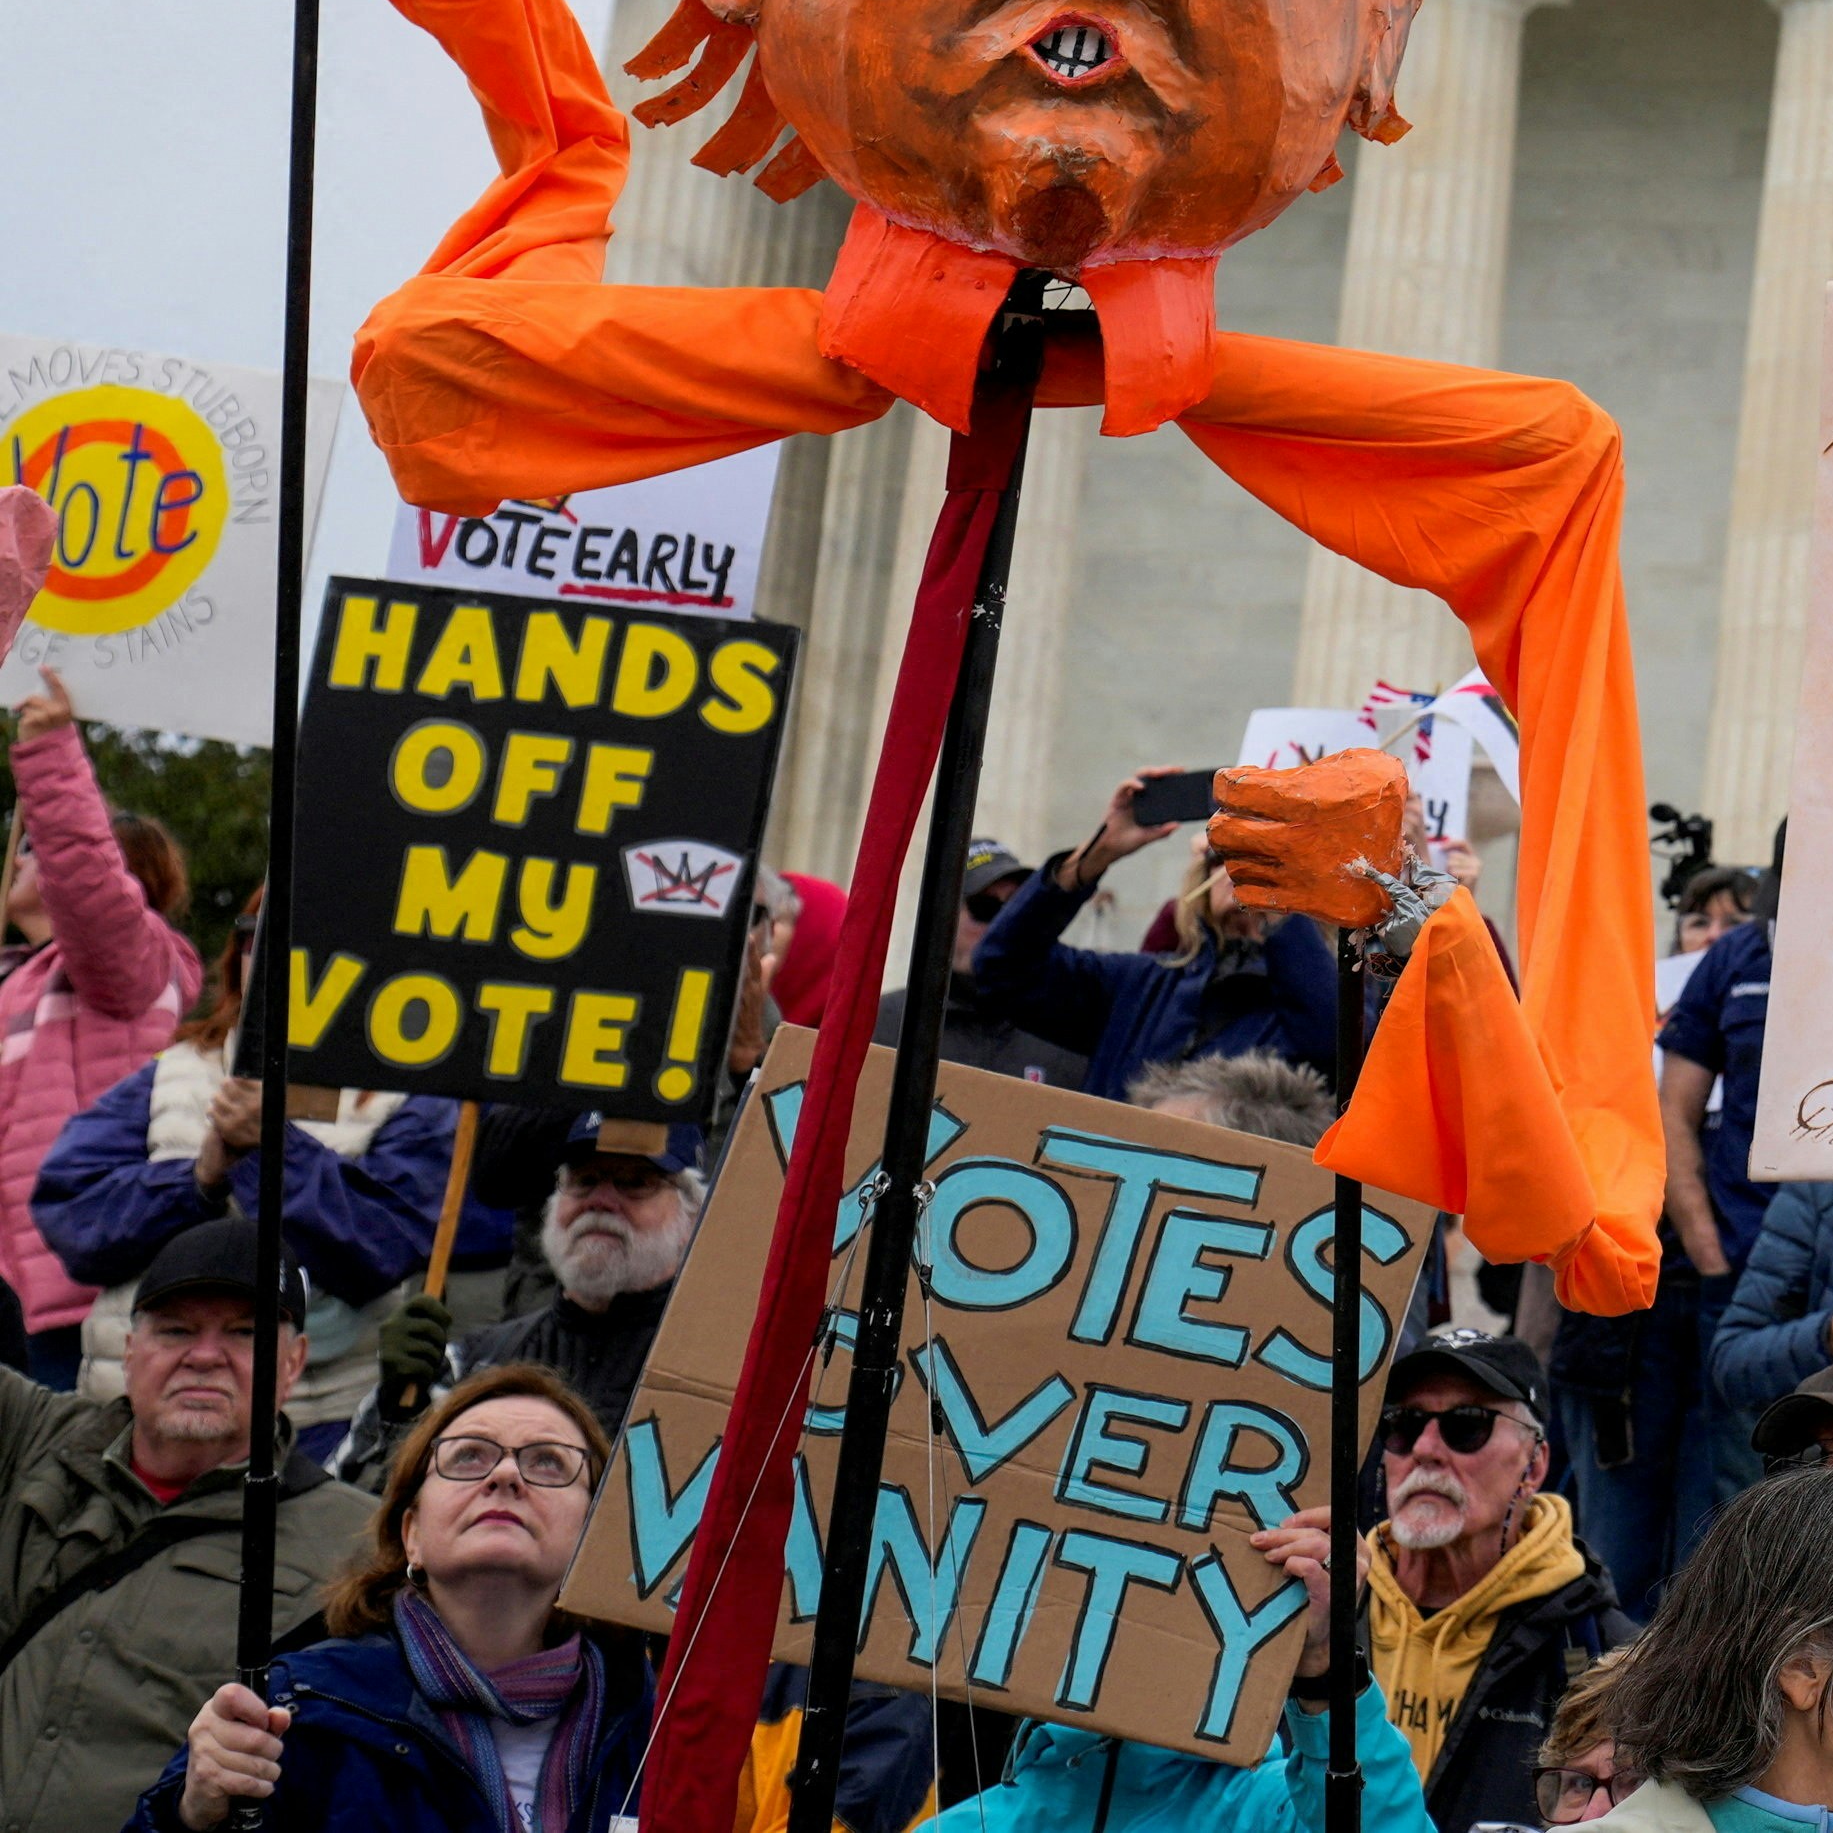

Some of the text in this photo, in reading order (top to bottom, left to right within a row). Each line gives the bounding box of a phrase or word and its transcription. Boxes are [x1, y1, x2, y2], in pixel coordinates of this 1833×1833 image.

[152, 357, 271, 526] STUBBORN
[415, 510, 736, 604] VOTE EARLY
[93, 588, 214, 669] STAINS
[329, 595, 780, 734] HANDS
[392, 722, 655, 835] OFF
[287, 948, 712, 1102] VOTE!
